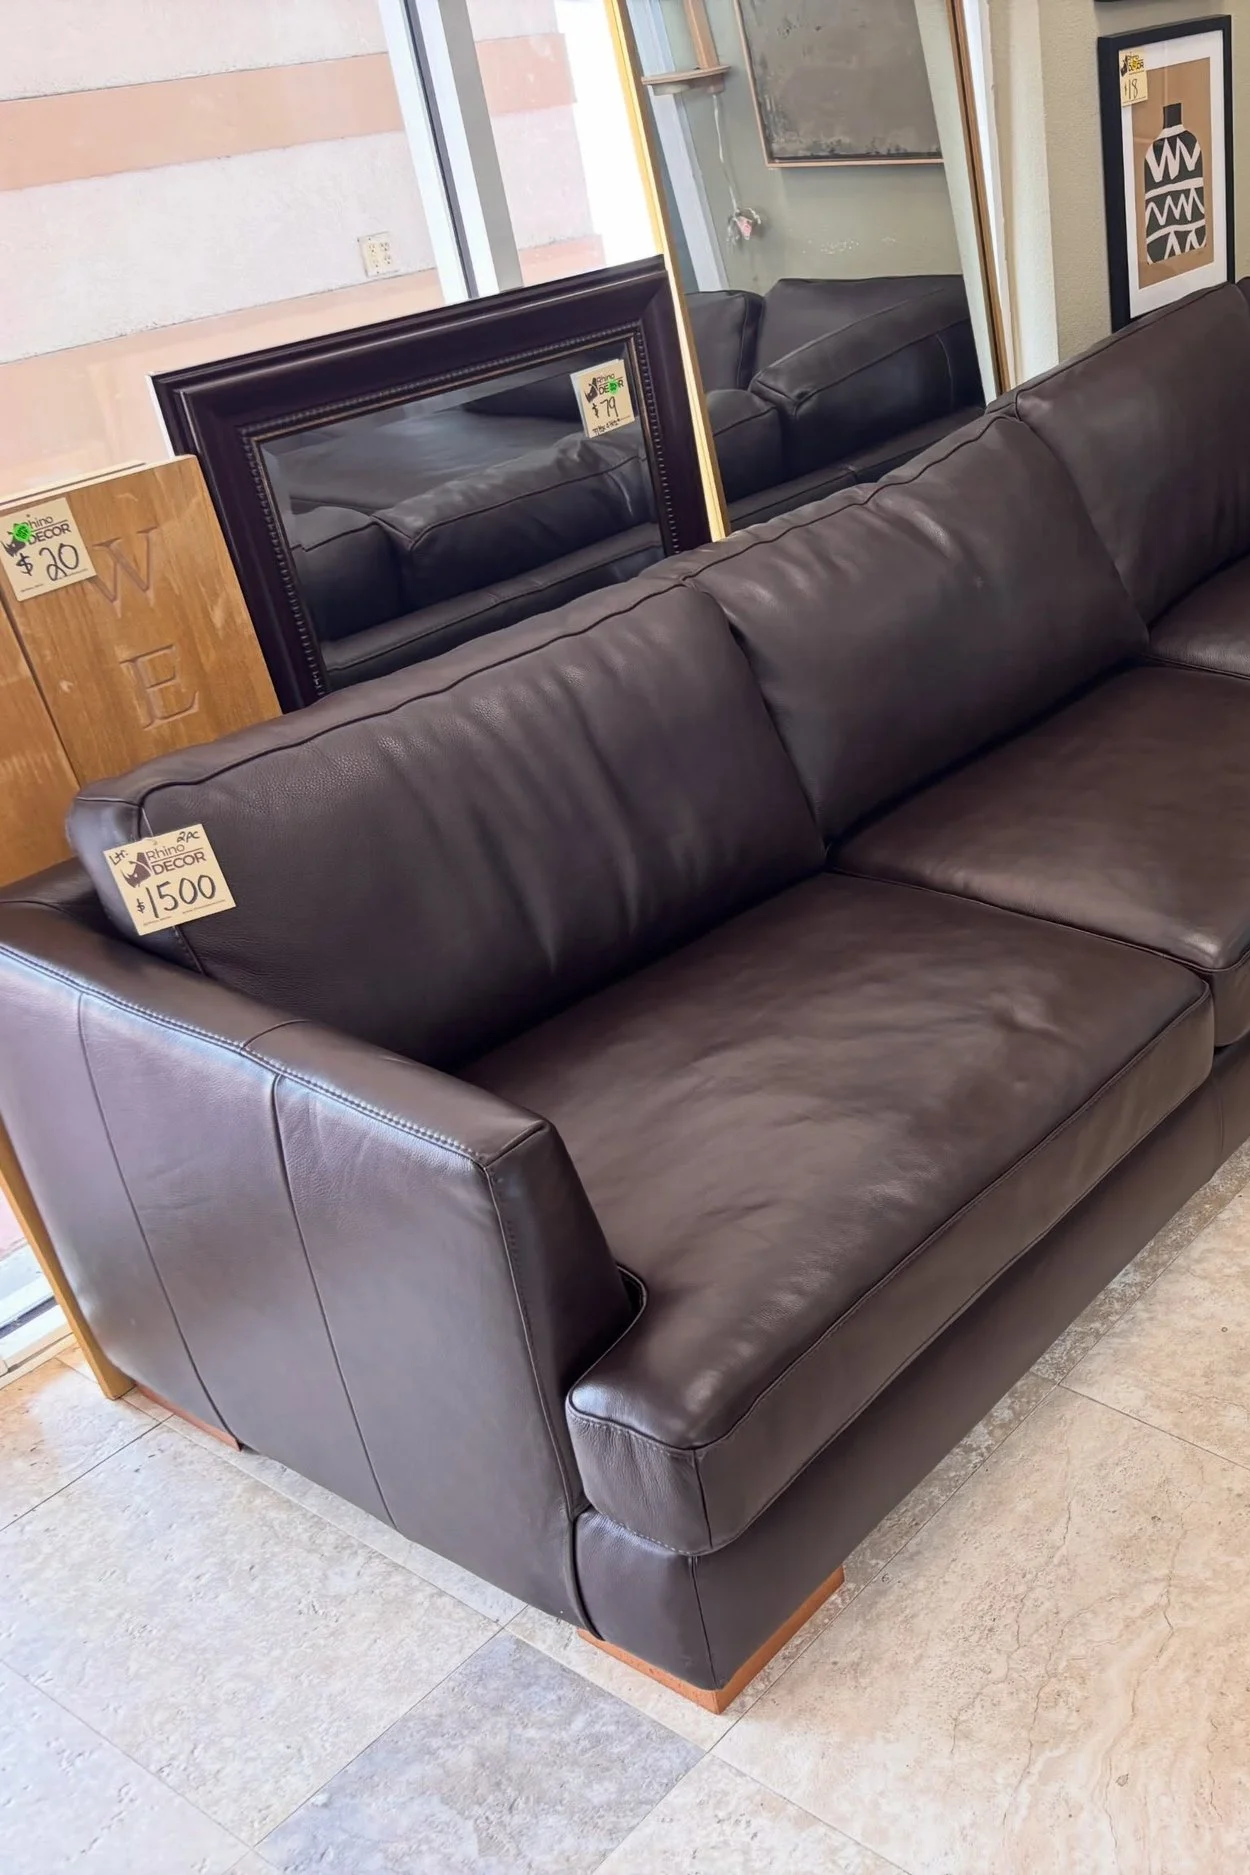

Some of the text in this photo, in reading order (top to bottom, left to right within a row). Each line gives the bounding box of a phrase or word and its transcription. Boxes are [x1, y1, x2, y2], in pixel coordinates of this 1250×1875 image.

[599, 379, 624, 396] DER
[591, 395, 619, 419] $79
[21, 515, 54, 532] hino
[28, 523, 72, 545] DECOR
[145, 843, 185, 862] Rhino
[151, 850, 207, 876] DECOR
[136, 874, 216, 919] $1500
